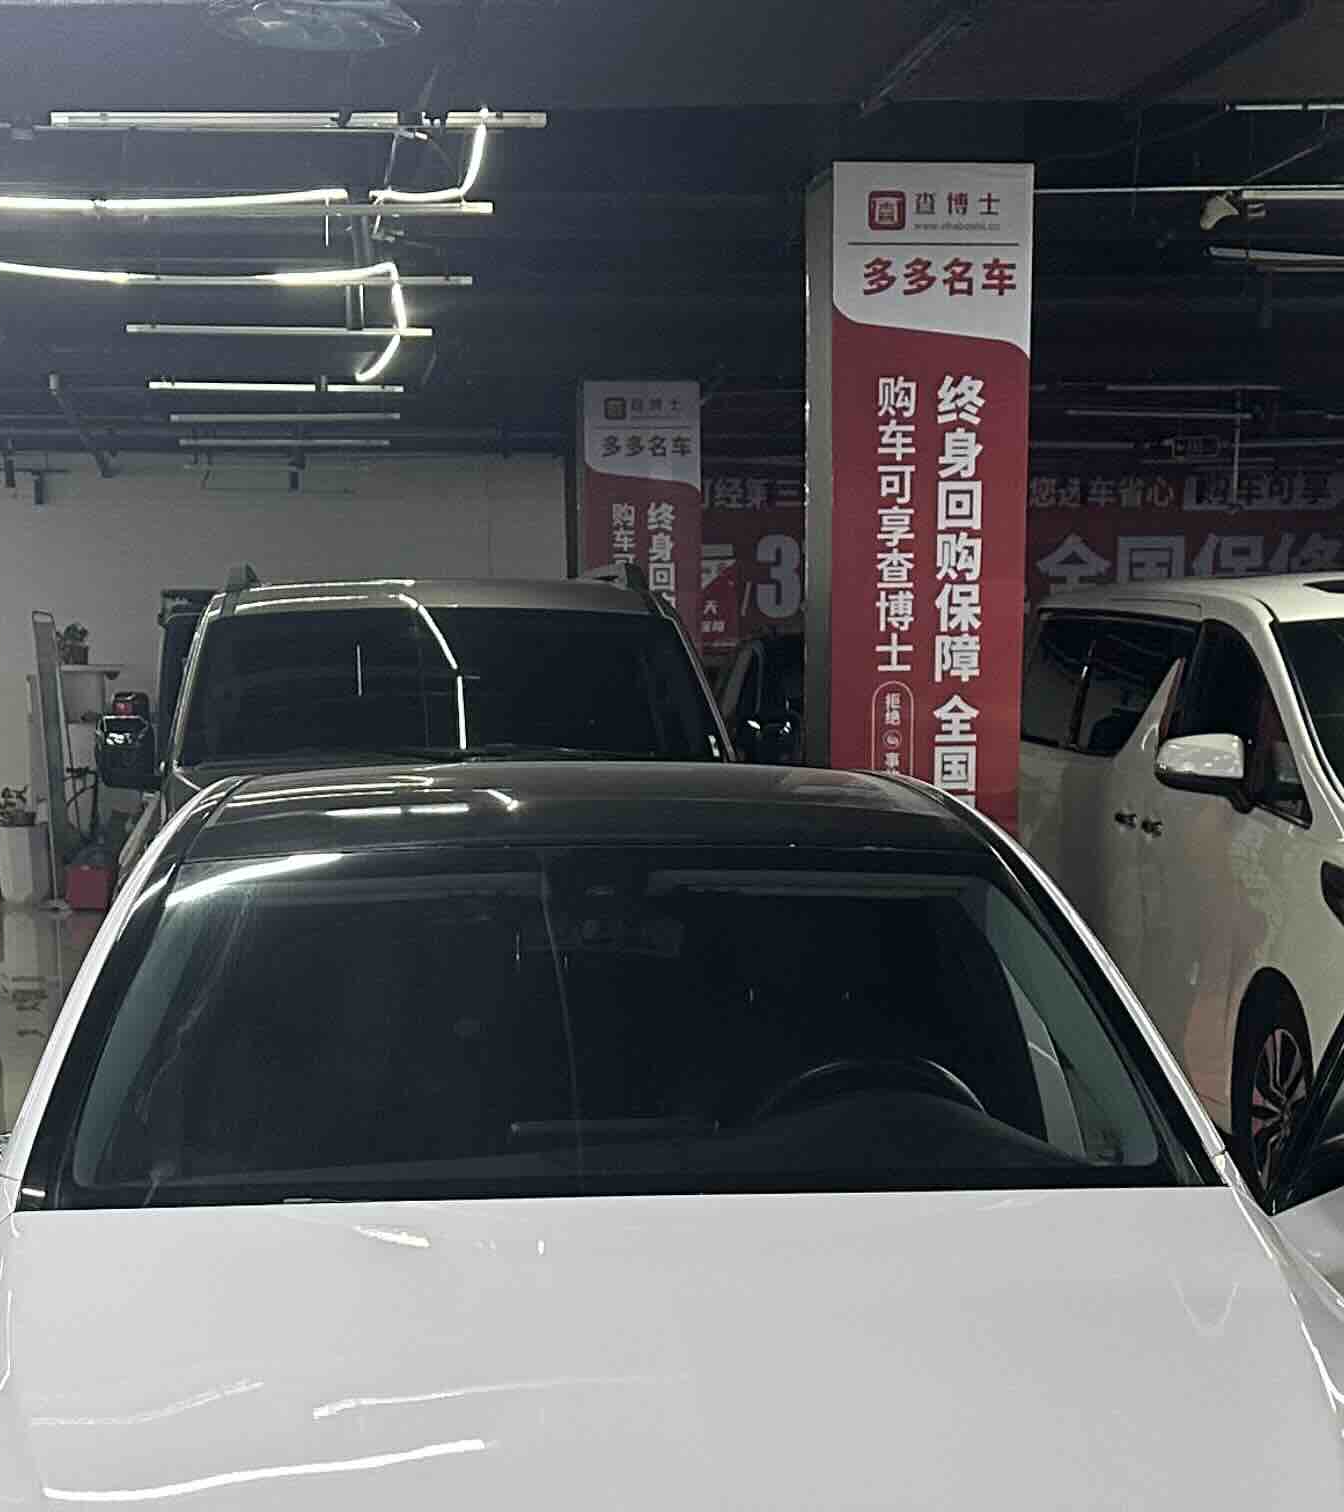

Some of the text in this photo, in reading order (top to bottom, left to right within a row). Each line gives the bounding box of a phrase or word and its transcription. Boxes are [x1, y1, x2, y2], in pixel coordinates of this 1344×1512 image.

[862, 257, 1017, 297] 多多名车
[602, 435, 692, 458] 多多名车
[647, 502, 676, 609] 终身回
[875, 376, 917, 673] 购车可享查博士
[932, 375, 986, 809] 终身回购保障 全国
